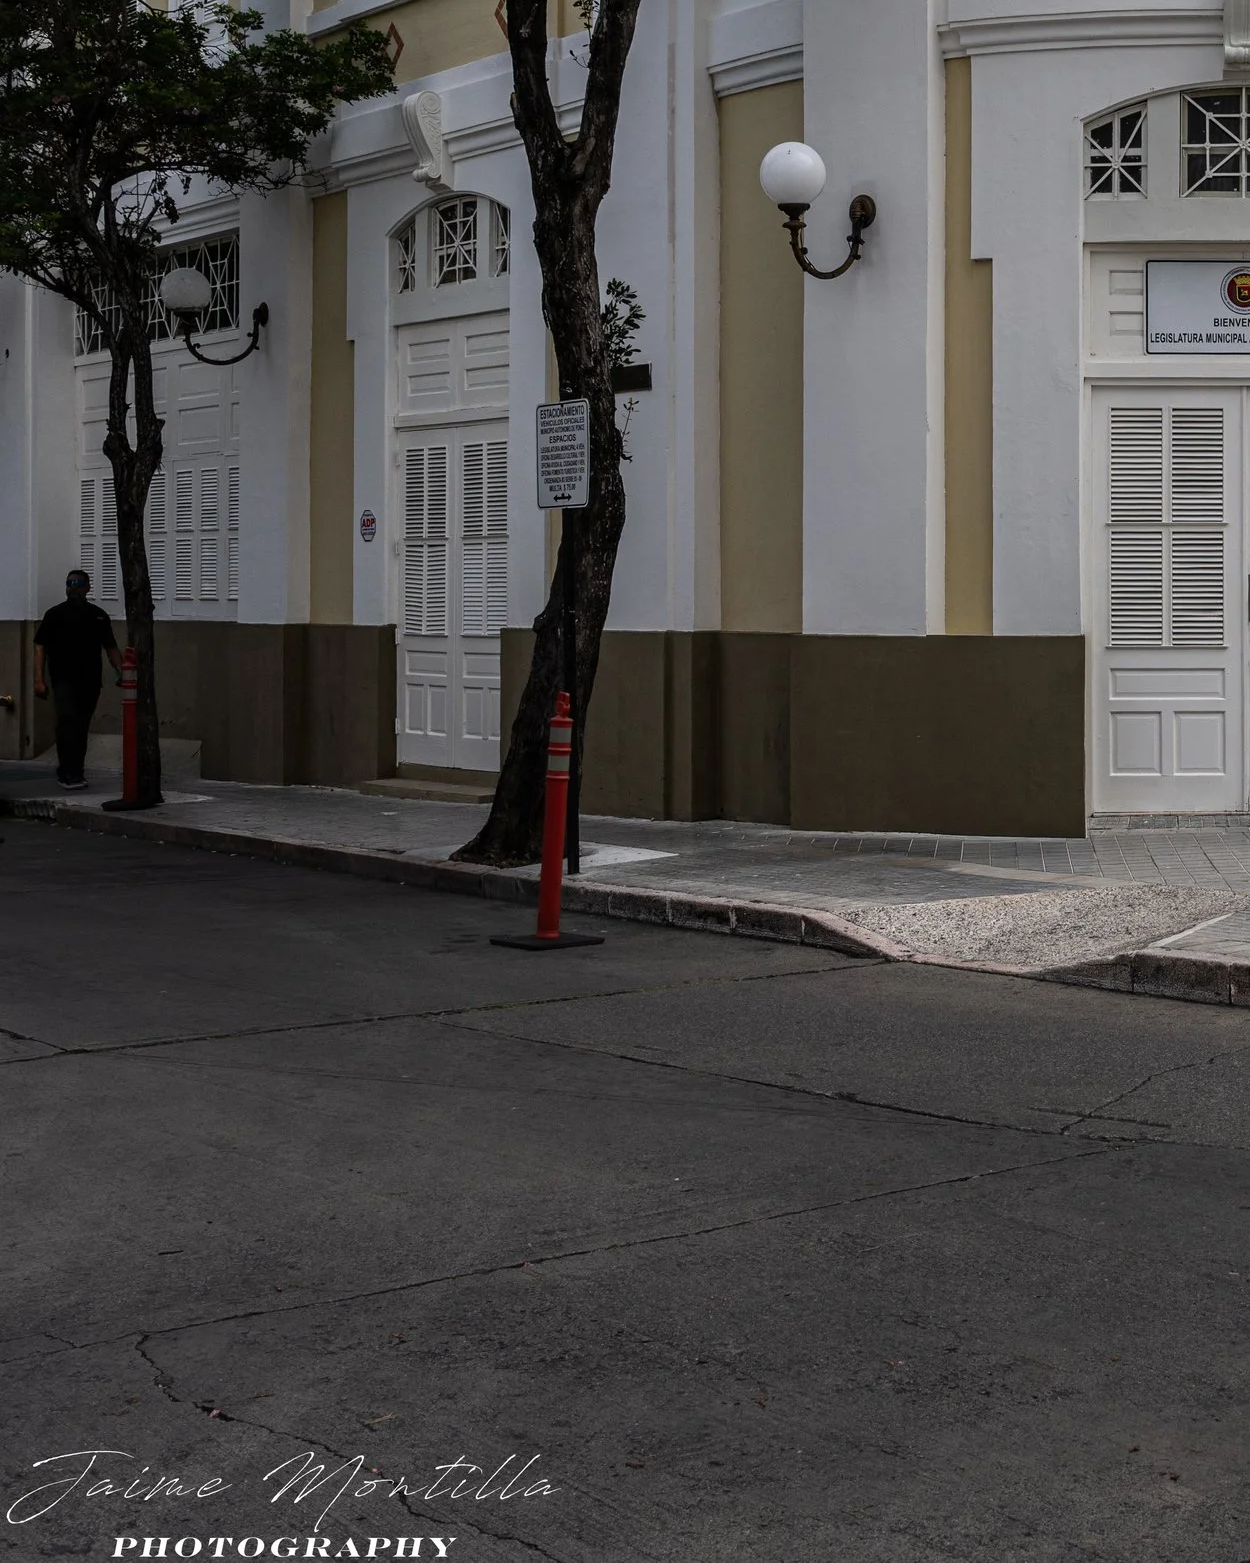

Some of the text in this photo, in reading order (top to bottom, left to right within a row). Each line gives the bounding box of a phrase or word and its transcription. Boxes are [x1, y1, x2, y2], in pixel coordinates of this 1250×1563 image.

[1150, 332, 1204, 344] LEGISLATURA
[1205, 332, 1248, 344] MUNICIPAL
[540, 404, 585, 420] ESTACIONAMIENTO
[563, 416, 585, 425] OFICIALES
[549, 434, 577, 444] ESPACIOS
[362, 518, 375, 529] ADP
